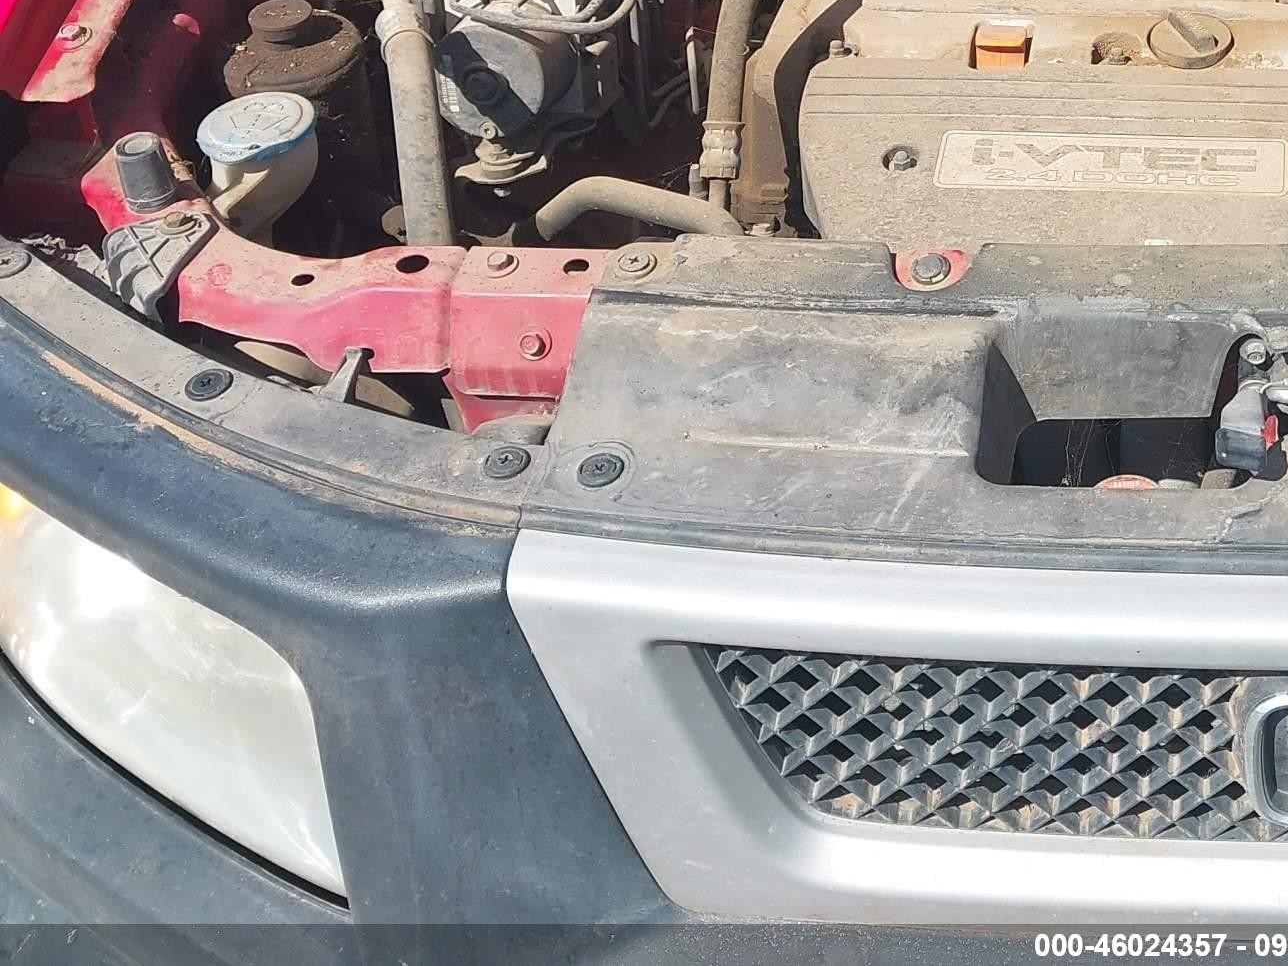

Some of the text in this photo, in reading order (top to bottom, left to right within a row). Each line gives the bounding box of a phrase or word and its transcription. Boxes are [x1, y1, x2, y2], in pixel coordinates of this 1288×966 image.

[971, 138, 1258, 173] i-VTEC
[983, 168, 1241, 187] 2.4 DOHC
